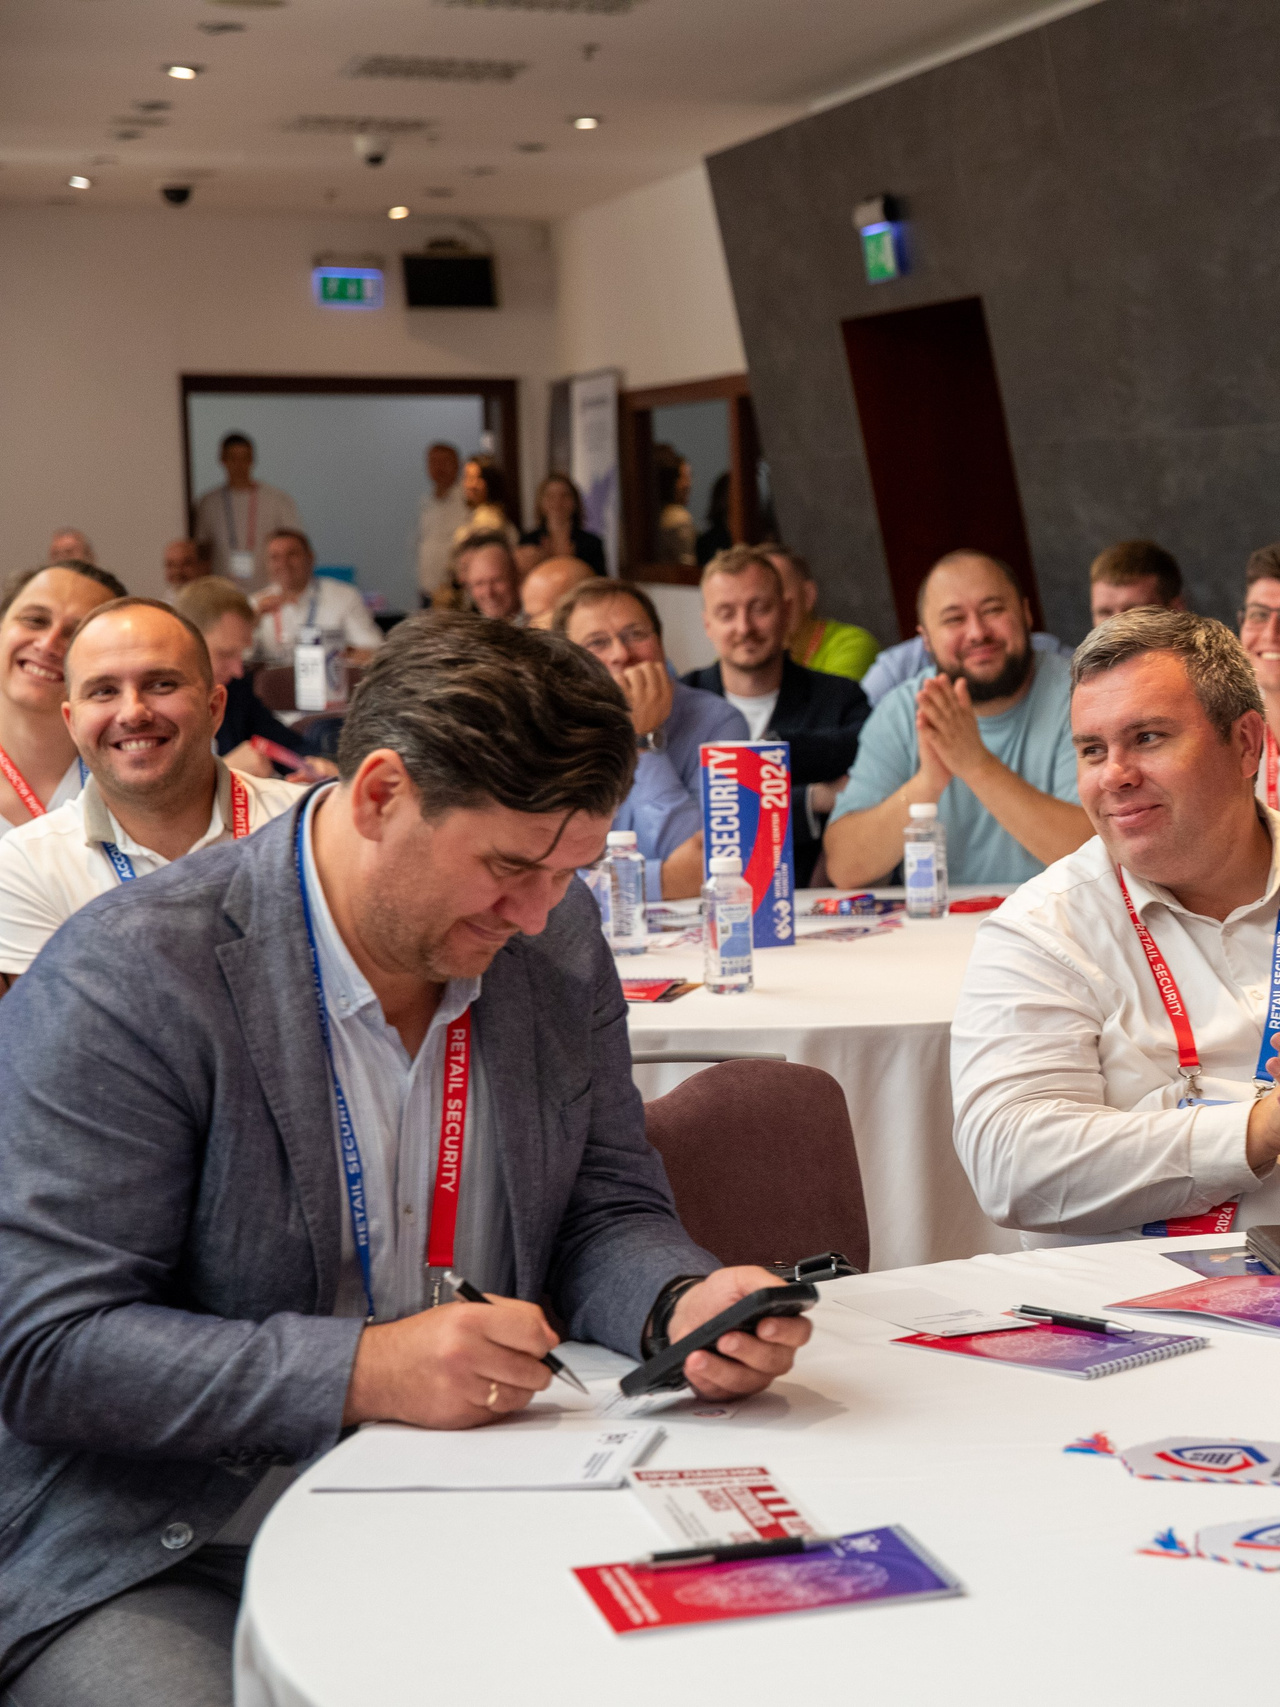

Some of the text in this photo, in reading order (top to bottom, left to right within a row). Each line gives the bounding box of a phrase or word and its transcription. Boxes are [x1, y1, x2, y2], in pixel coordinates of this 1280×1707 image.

[759, 748, 787, 810] 2024
[1134, 923, 1185, 1018] RETAIL SECURITY
[438, 1028, 467, 1193] RETAIL SECURITY
[350, 1179, 368, 1247] RETAIL
[1214, 1207, 1235, 1233] 2024
